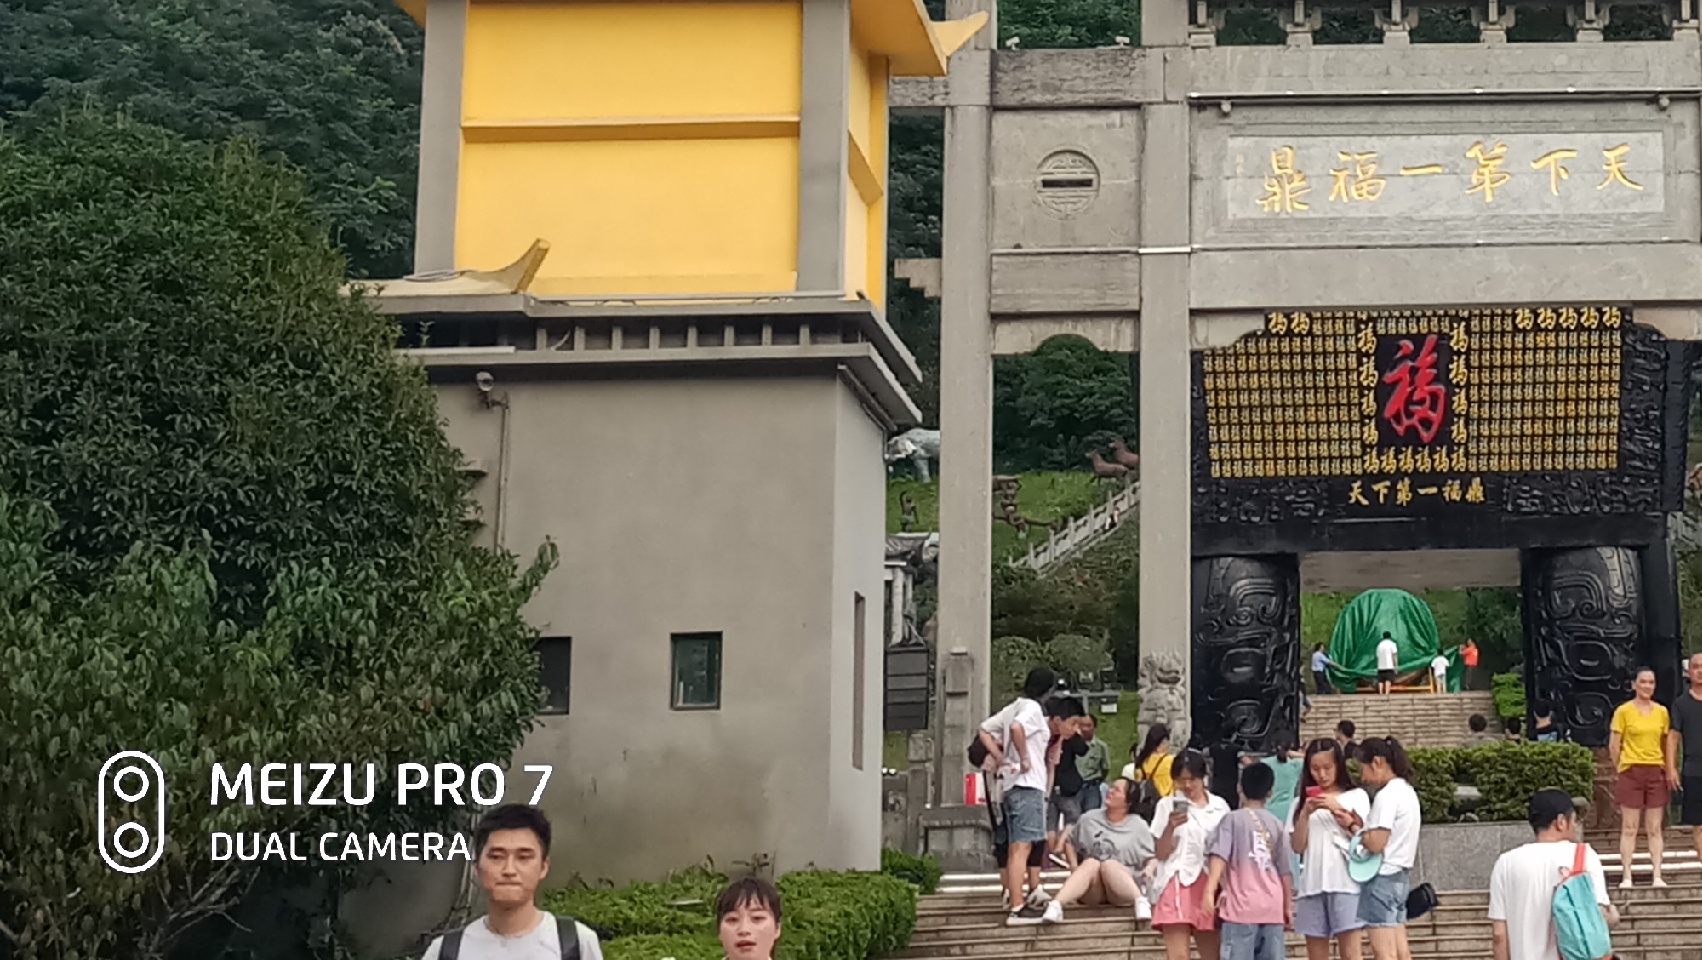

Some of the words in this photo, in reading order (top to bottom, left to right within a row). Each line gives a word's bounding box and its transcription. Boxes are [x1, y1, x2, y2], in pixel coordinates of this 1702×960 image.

[1382, 334, 1447, 444] 福
[1348, 477, 1486, 507] 天下第一福鼎
